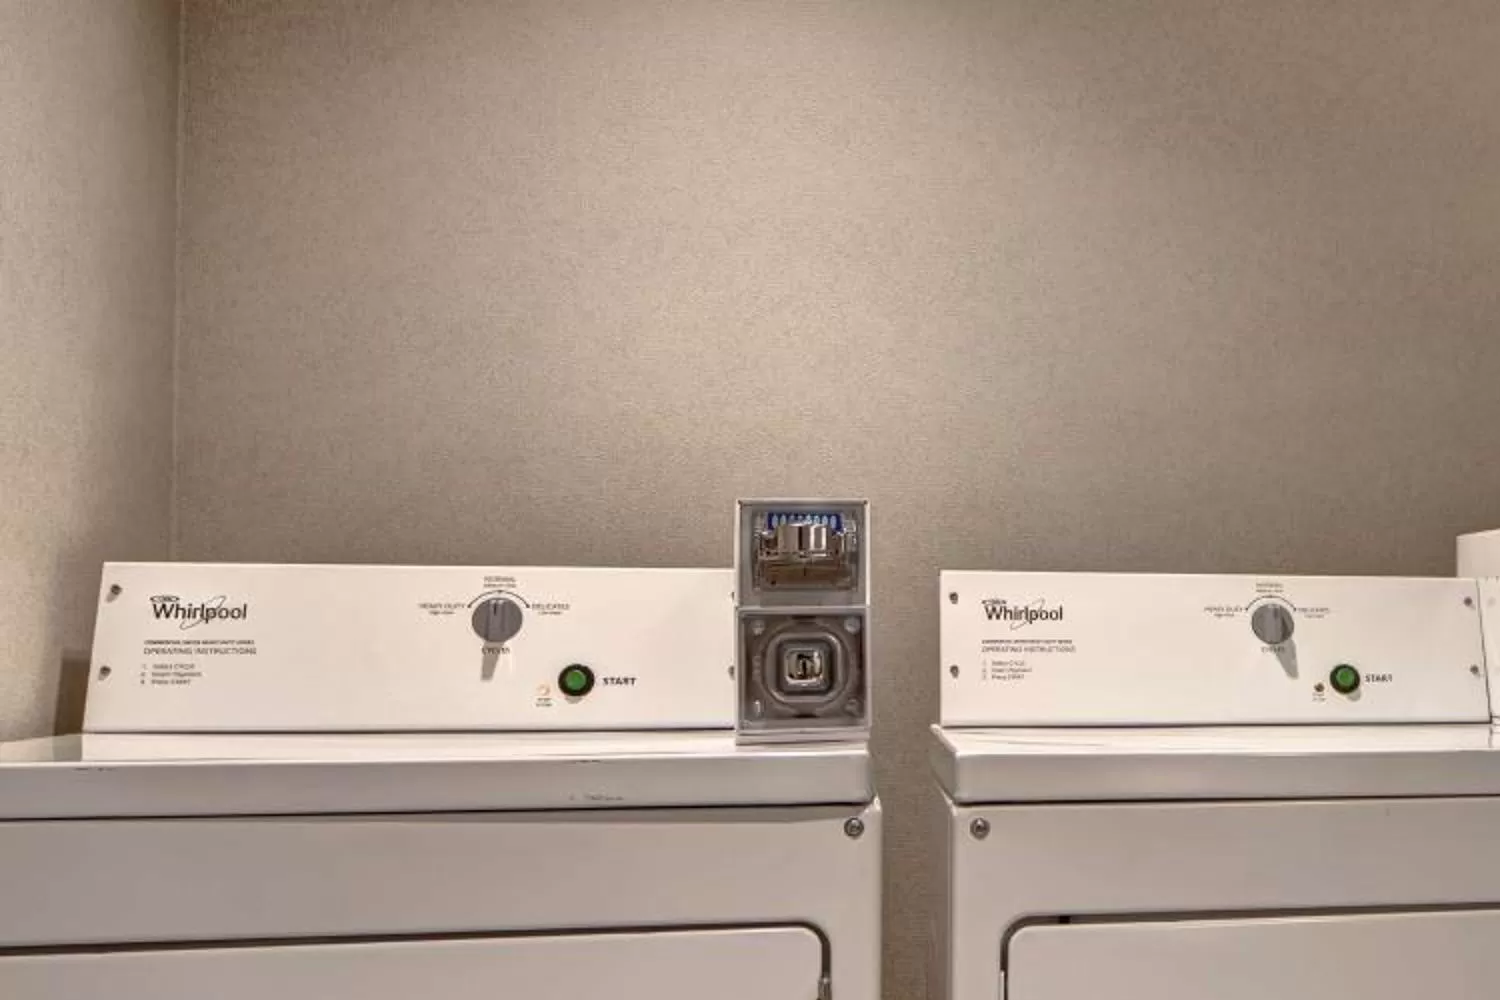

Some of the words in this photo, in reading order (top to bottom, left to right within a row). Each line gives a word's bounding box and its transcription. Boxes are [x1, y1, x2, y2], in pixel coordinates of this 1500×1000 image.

[152, 603, 248, 624] Whirlpool
[984, 605, 1063, 625] Whirlpool
[602, 677, 637, 686] START
[1365, 673, 1393, 683] START
